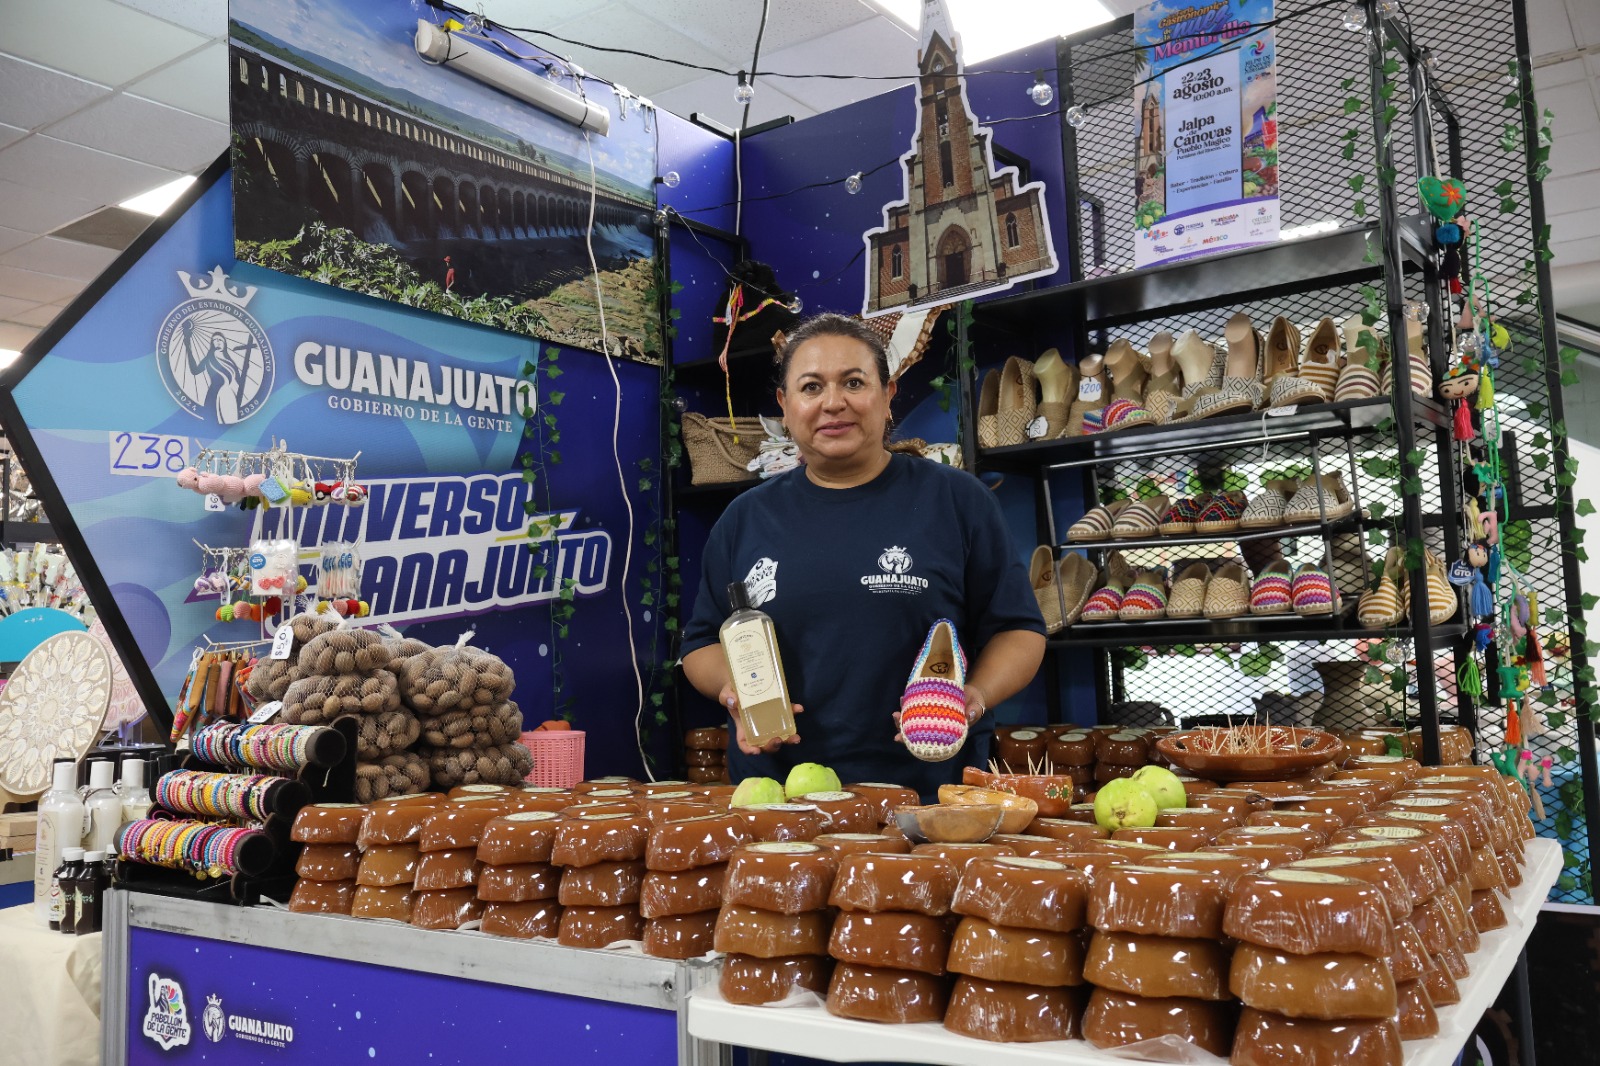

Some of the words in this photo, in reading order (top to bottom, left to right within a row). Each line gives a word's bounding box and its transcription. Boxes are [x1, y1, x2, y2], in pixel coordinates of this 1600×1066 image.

[1173, 76, 1224, 100] agosto
[1193, 90, 1216, 102] 10:00
[1216, 86, 1233, 96] a.m.
[1178, 115, 1215, 133] Jalpa
[1173, 125, 1233, 149] Cánovas
[1177, 143, 1203, 155] Pueblo
[160, 312, 183, 354] GOBIERNO
[181, 304, 198, 316] DEL
[199, 301, 232, 313] ESTADO
[233, 308, 245, 320] DE
[244, 317, 271, 373] GUANAJUATO
[293, 341, 537, 418] GUANAJUATO
[1080, 383, 1101, 394] $200
[176, 390, 197, 412] 2024
[239, 399, 260, 416] 2030
[327, 395, 415, 419] GOBIERNO
[420, 408, 440, 423] DE
[444, 411, 463, 427] LA
[467, 415, 513, 433] GENTE
[113, 433, 186, 473] 238
[860, 574, 928, 589] GUANAJUATO
[1454, 569, 1472, 577] GTO
[147, 1022, 156, 1032] DE
[156, 1023, 165, 1033] LA
[165, 1025, 187, 1039] GENTE
[228, 1014, 294, 1043] GUANAJUATO
[235, 1032, 258, 1043] GOBIERNO
[271, 1039, 286, 1048] GENTE
